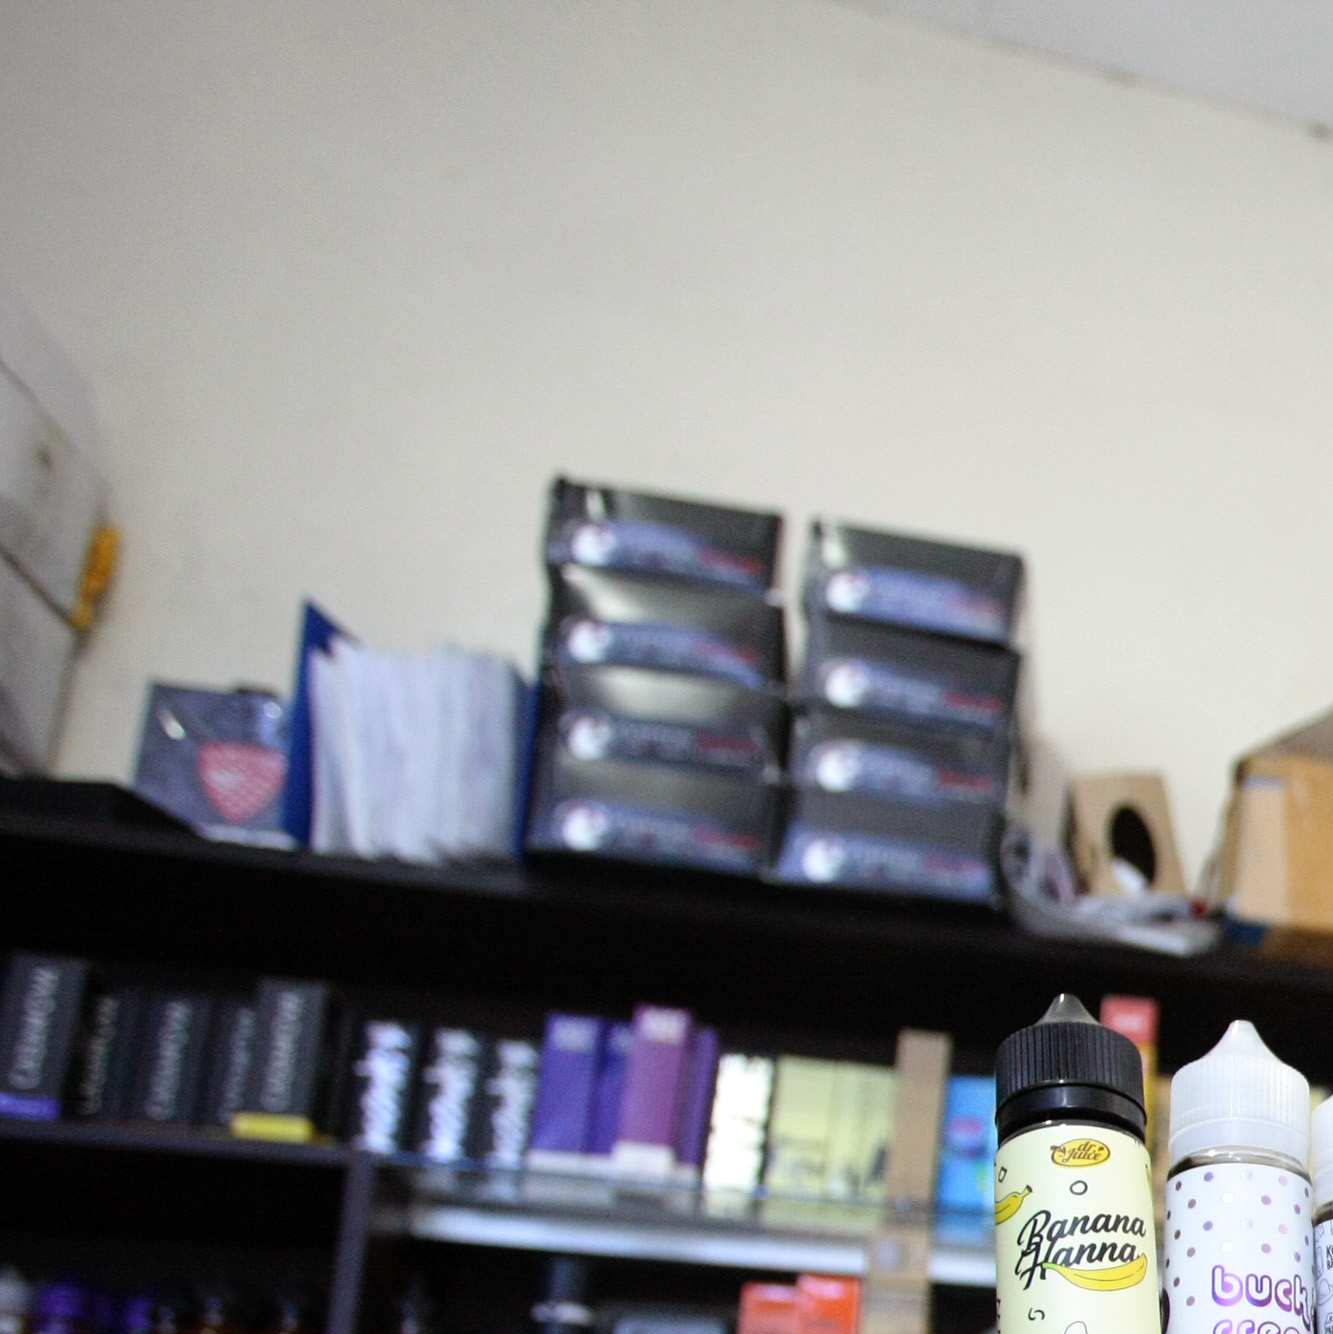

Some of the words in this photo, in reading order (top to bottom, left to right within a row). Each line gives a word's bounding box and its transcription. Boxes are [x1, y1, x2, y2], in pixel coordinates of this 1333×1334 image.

[1017, 1209, 1146, 1246] Banana
[1014, 1241, 1141, 1291] Hanna
[1211, 1264, 1316, 1332] buck
